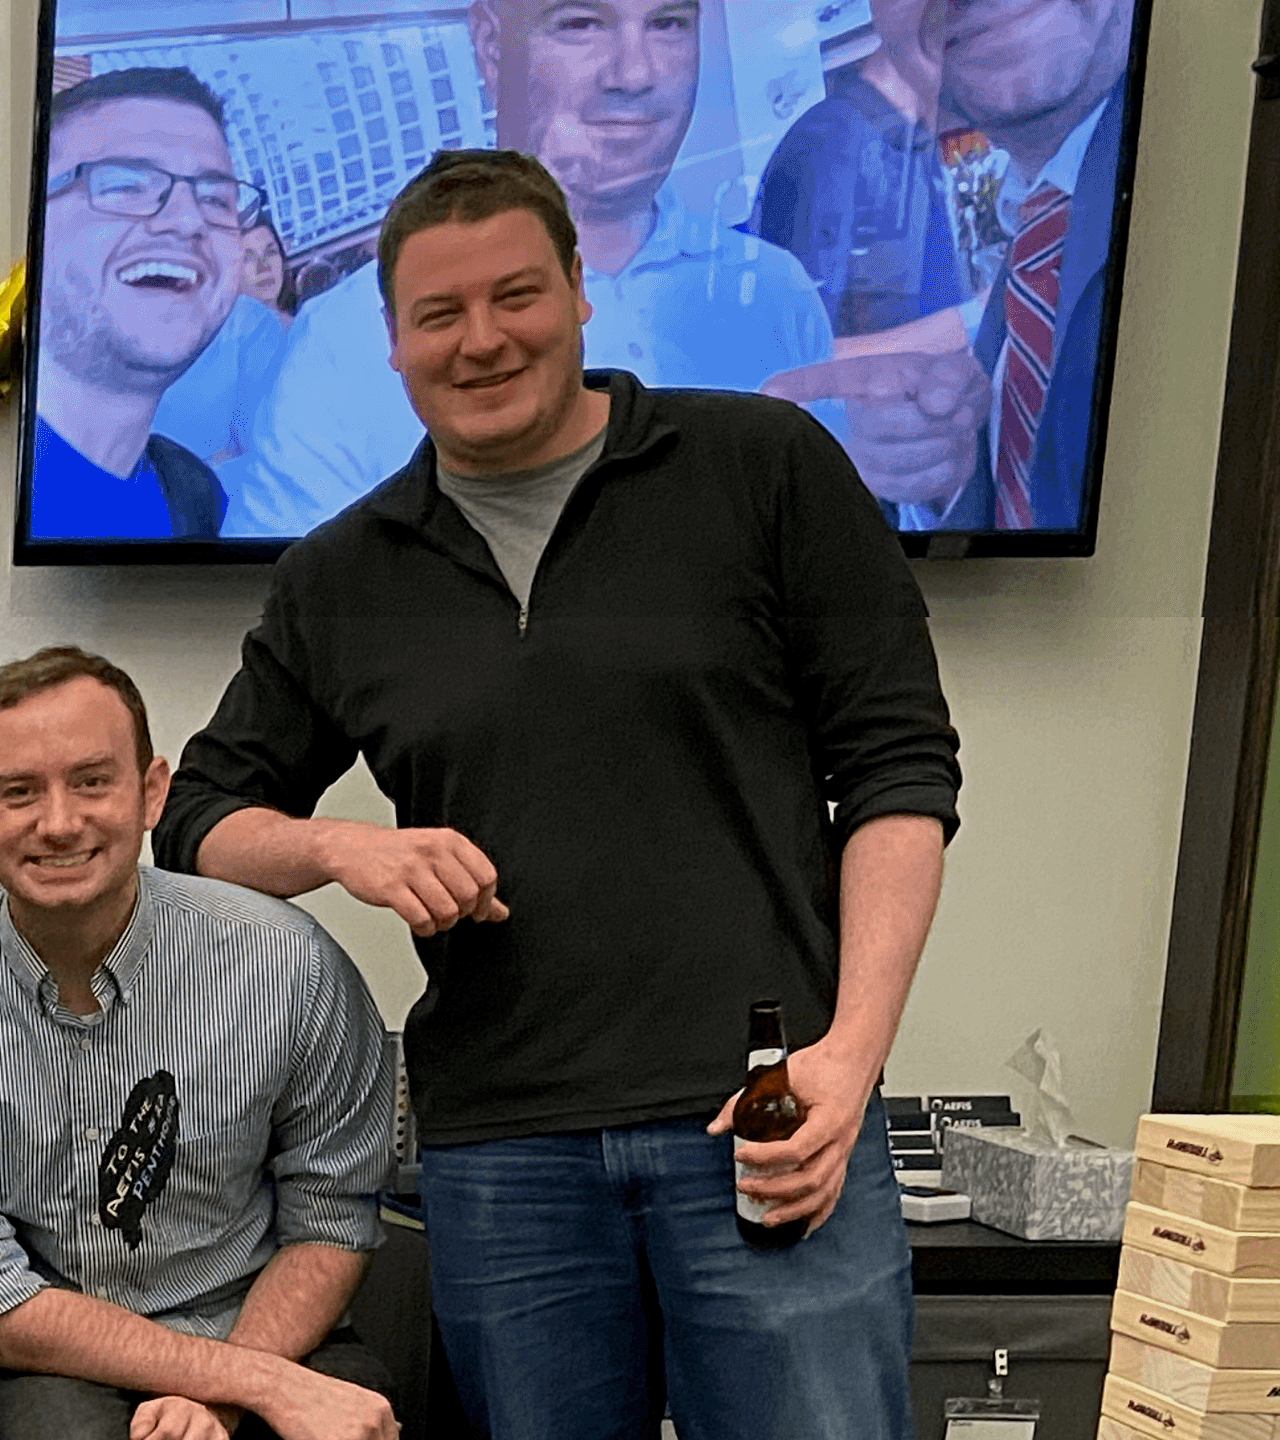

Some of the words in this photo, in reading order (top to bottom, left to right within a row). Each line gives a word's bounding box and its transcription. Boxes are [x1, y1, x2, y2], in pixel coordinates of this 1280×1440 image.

[944, 1101, 973, 1111] AEFIS
[105, 1144, 129, 1174] TO
[107, 1147, 145, 1217] AEFIS
